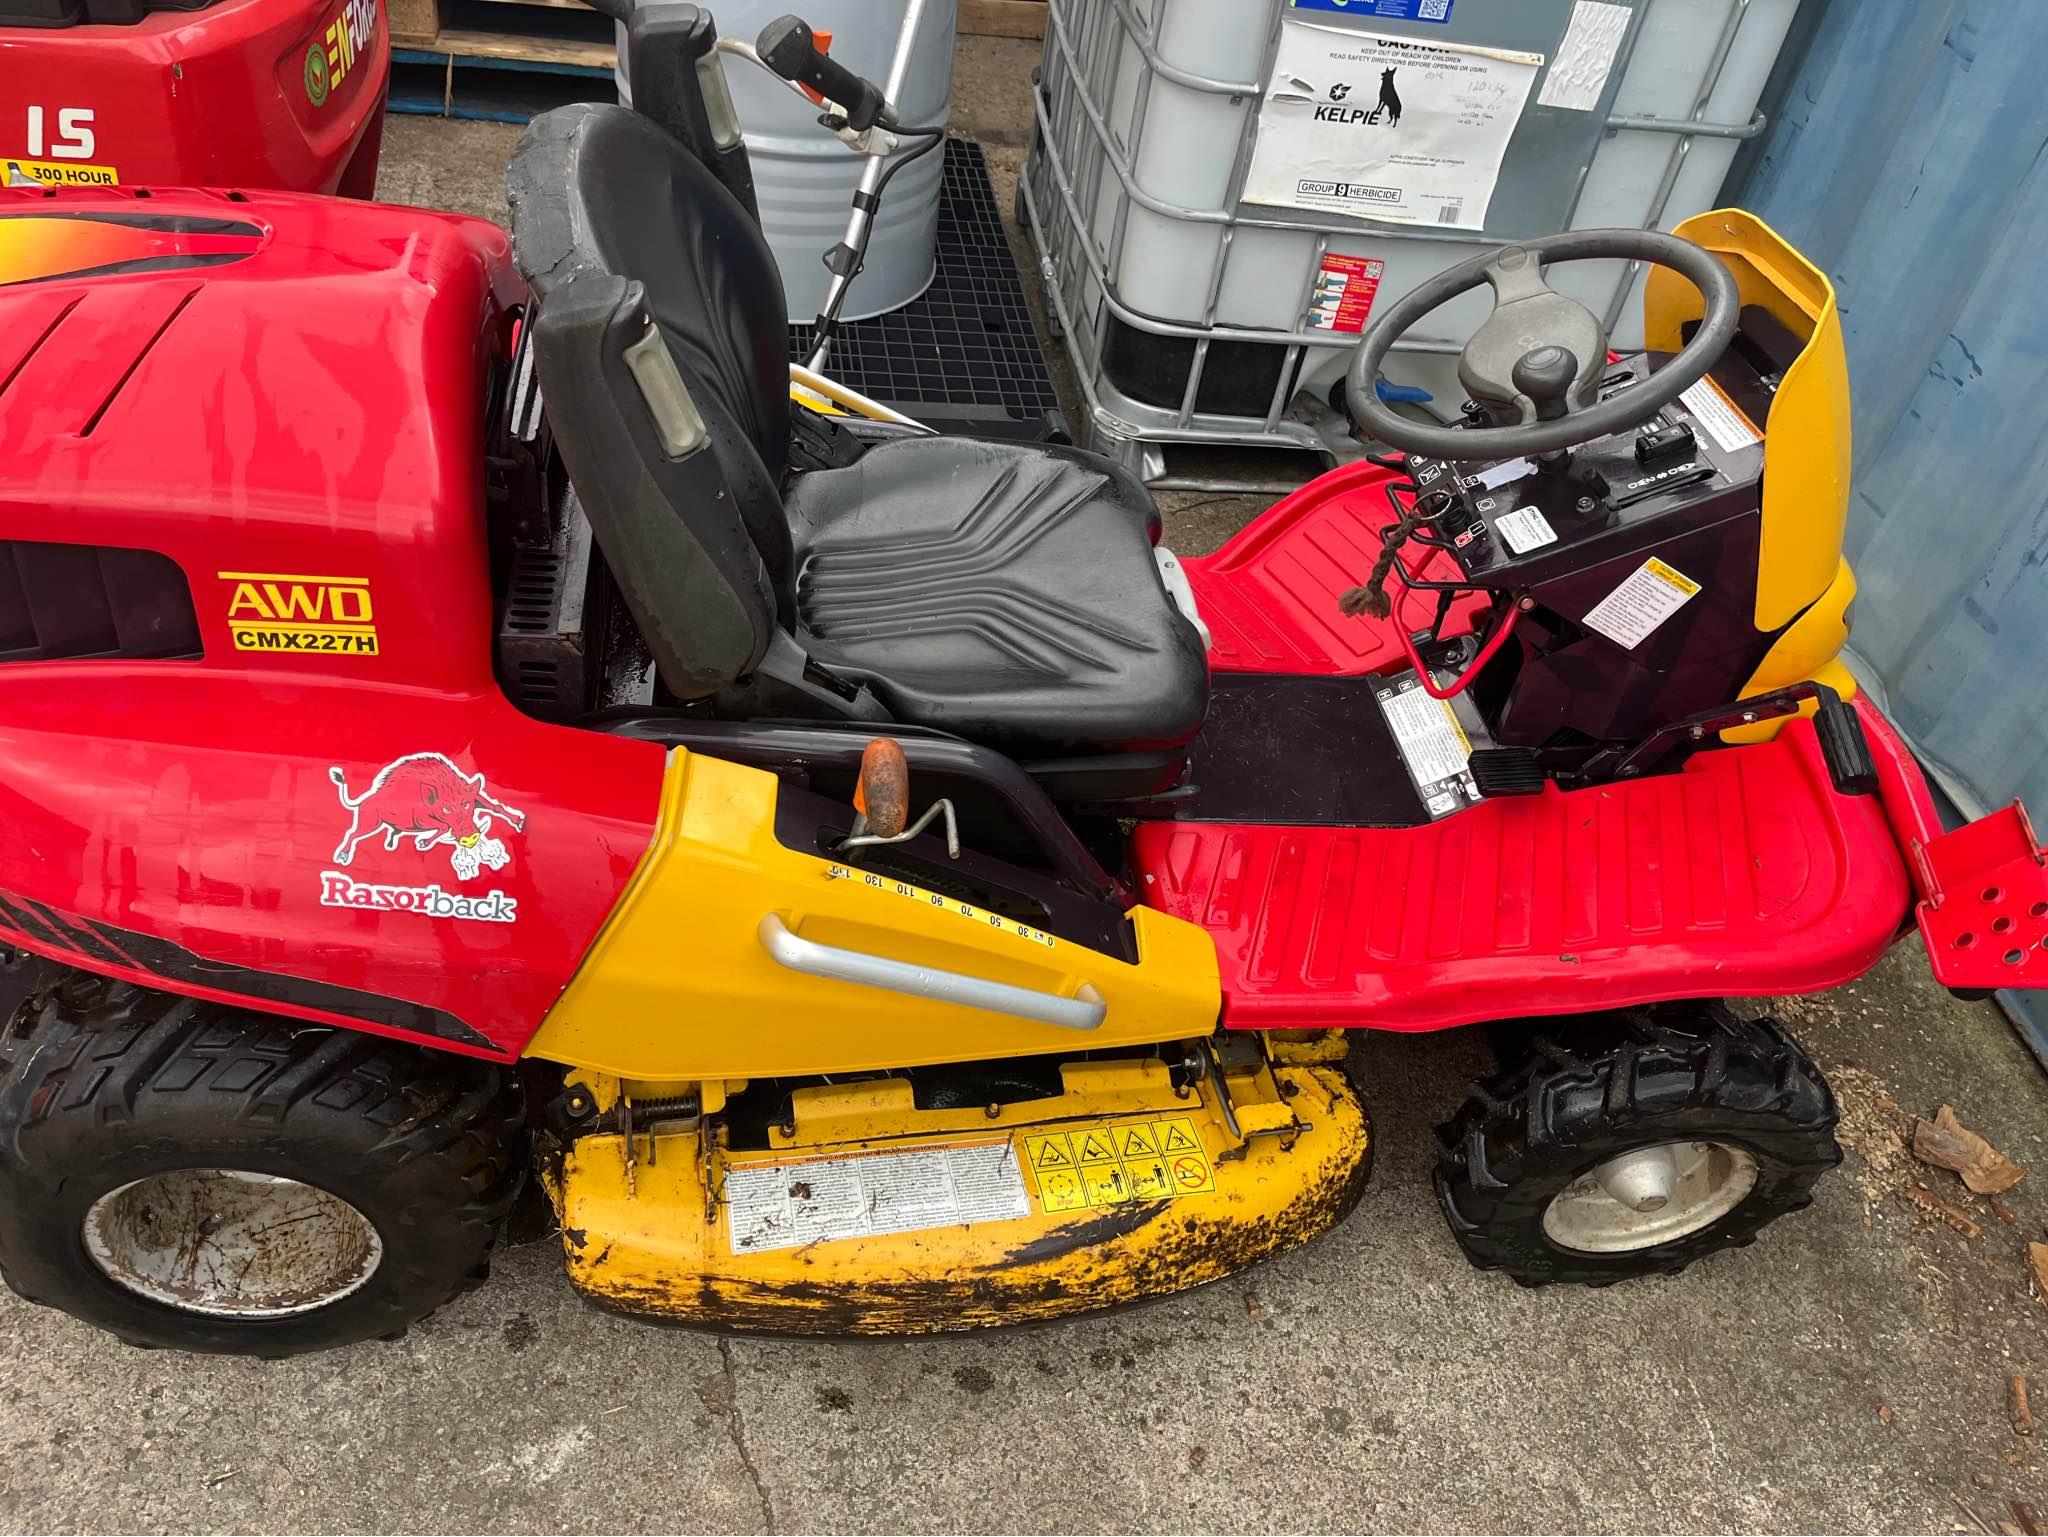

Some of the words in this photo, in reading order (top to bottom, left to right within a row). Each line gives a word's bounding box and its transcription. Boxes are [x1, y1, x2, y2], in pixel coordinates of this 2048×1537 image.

[1347, 54, 1370, 62] SAFETY
[1371, 56, 1406, 66] DIRECTIONS
[1407, 60, 1431, 68] BEFORE
[1432, 63, 1458, 71] OPENING
[1432, 55, 1461, 63] CHILDREN
[1314, 105, 1381, 126] KELPIE
[33, 167, 63, 181] 300
[66, 169, 113, 185] HOUR
[1301, 182, 1334, 193] GROUP
[1337, 183, 1346, 196] 9
[1349, 186, 1398, 200] HERBICIDE
[228, 582, 373, 622] AWD
[236, 631, 375, 652] CMX227H
[865, 874, 883, 888] 130
[897, 883, 915, 897] 110
[323, 876, 515, 921] Razorback
[931, 895, 943, 906] 90
[961, 905, 973, 917] 70
[990, 915, 1001, 927] 50
[1018, 926, 1029, 938] 30
